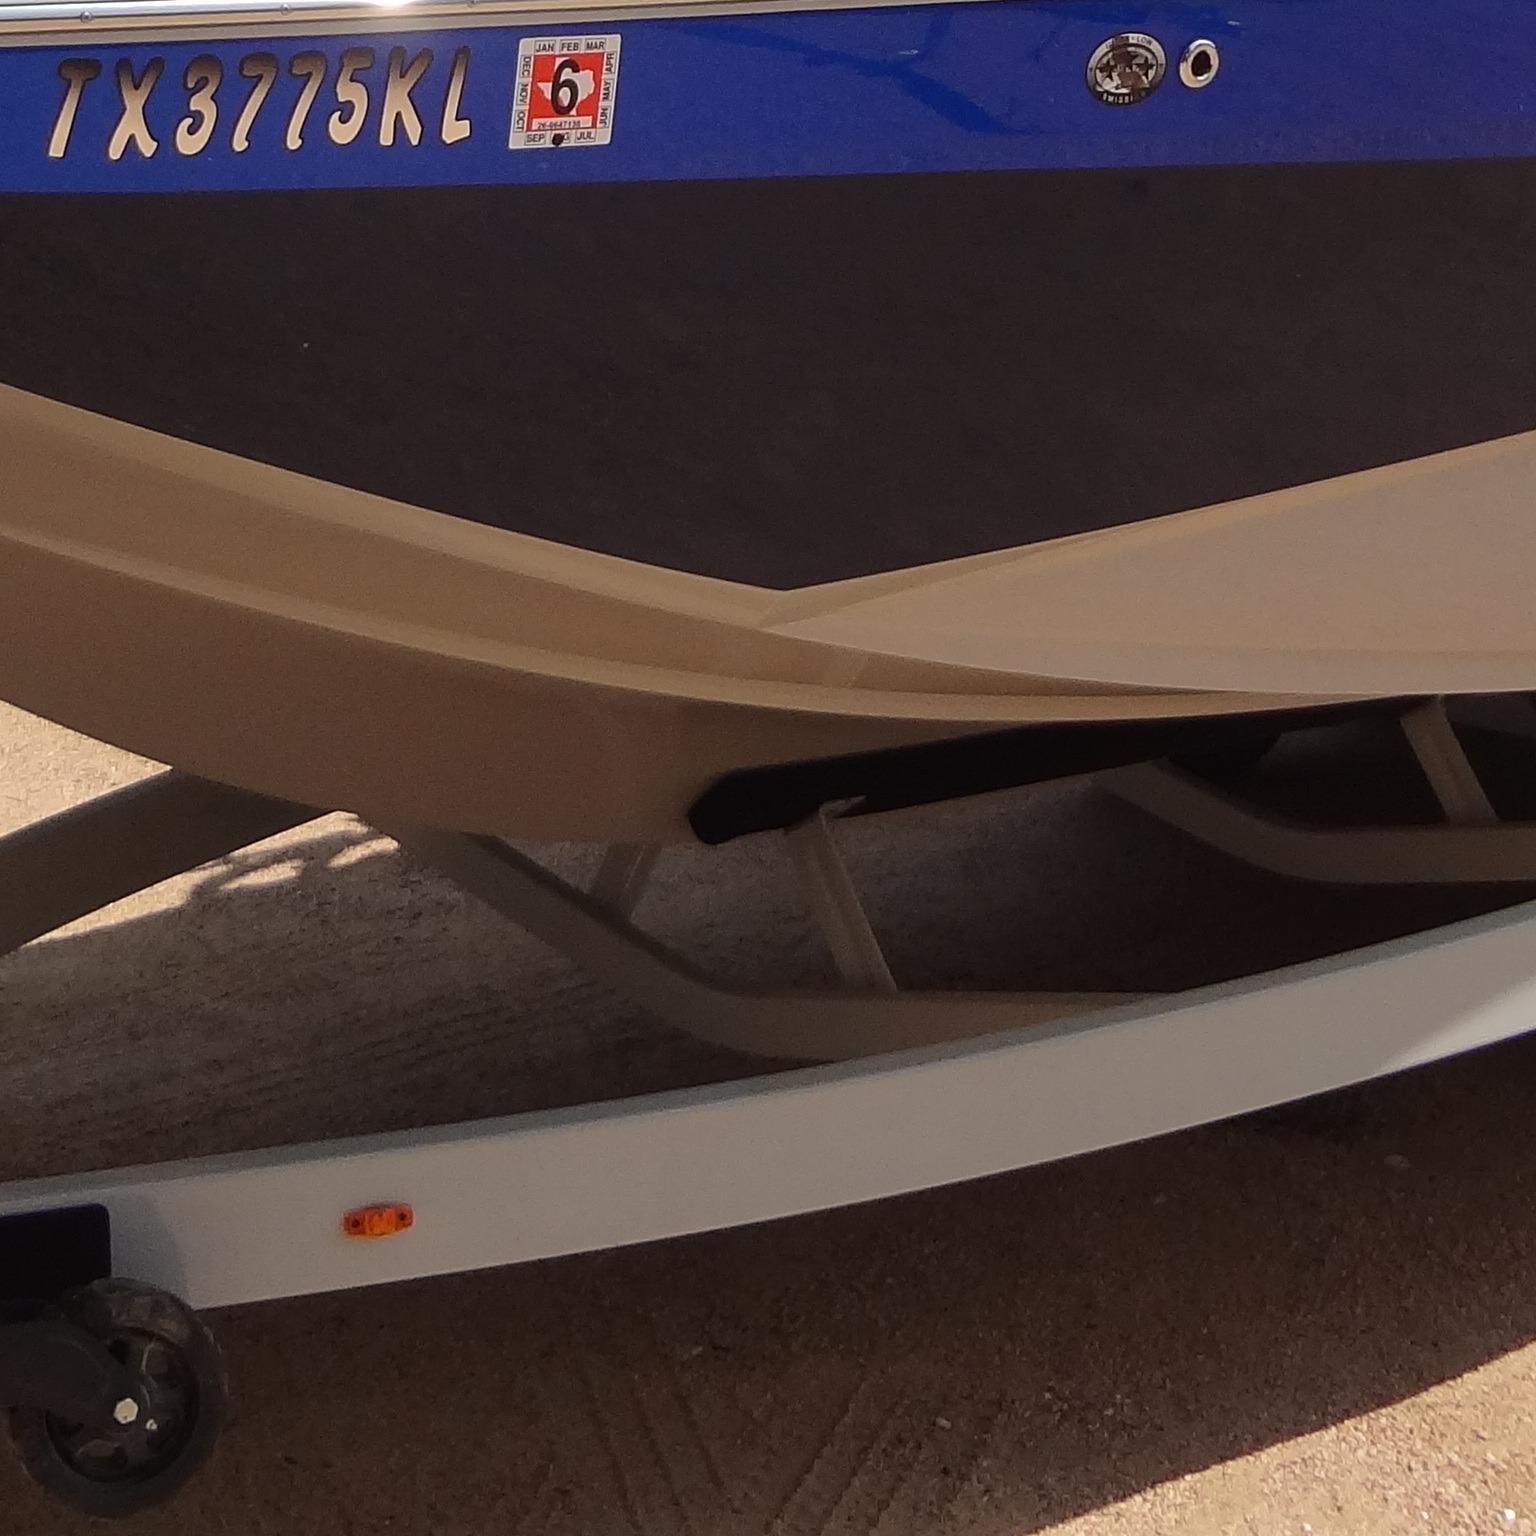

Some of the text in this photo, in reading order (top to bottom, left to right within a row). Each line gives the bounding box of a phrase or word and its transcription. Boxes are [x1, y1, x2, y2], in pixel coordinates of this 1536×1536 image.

[535, 41, 605, 52] JAN FEB MAR
[522, 57, 531, 75] DEC
[605, 53, 614, 73] APR
[520, 84, 528, 103] NOV
[551, 59, 580, 115] 6
[602, 81, 612, 101] MAY
[517, 111, 526, 129] OCT
[599, 108, 609, 128] JUN
[527, 133, 545, 142] SEP
[577, 131, 594, 140] JUL
